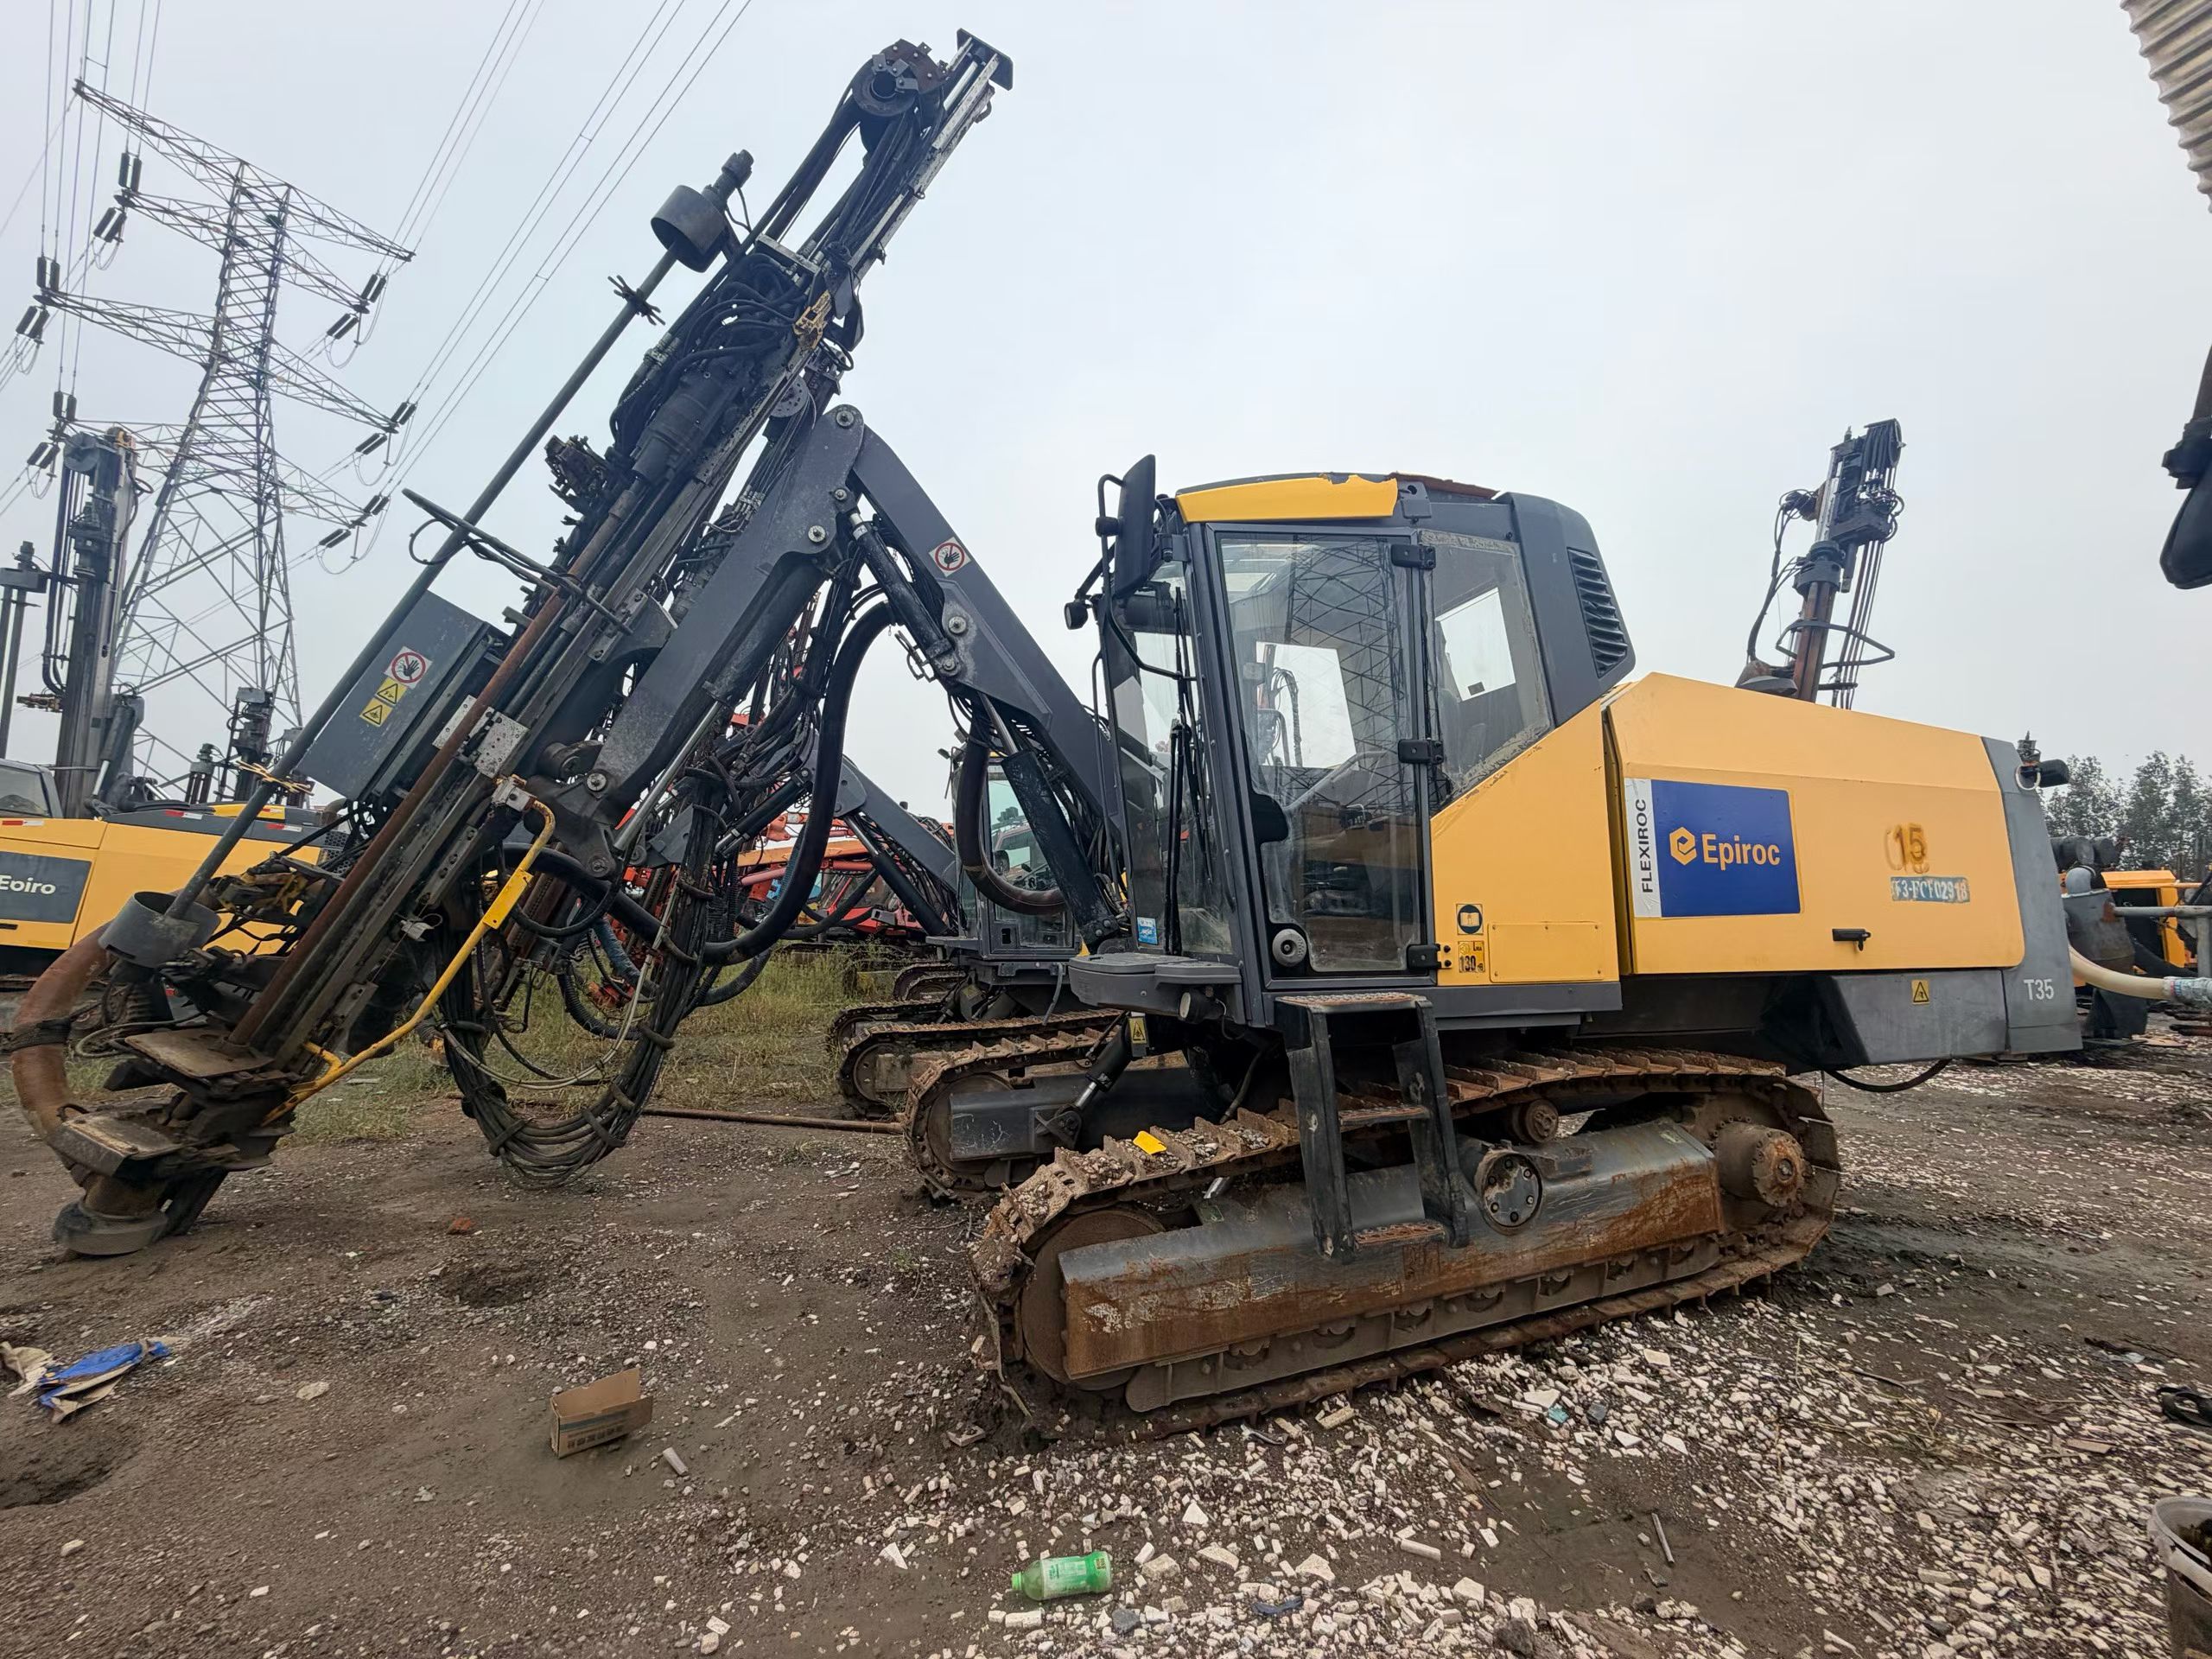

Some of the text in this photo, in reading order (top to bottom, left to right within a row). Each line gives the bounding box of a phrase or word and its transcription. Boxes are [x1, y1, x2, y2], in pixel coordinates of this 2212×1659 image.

[1636, 798, 1654, 893] FLEXIROC
[1702, 834, 1780, 870] Epiroc
[2024, 979, 2054, 1000] T35
